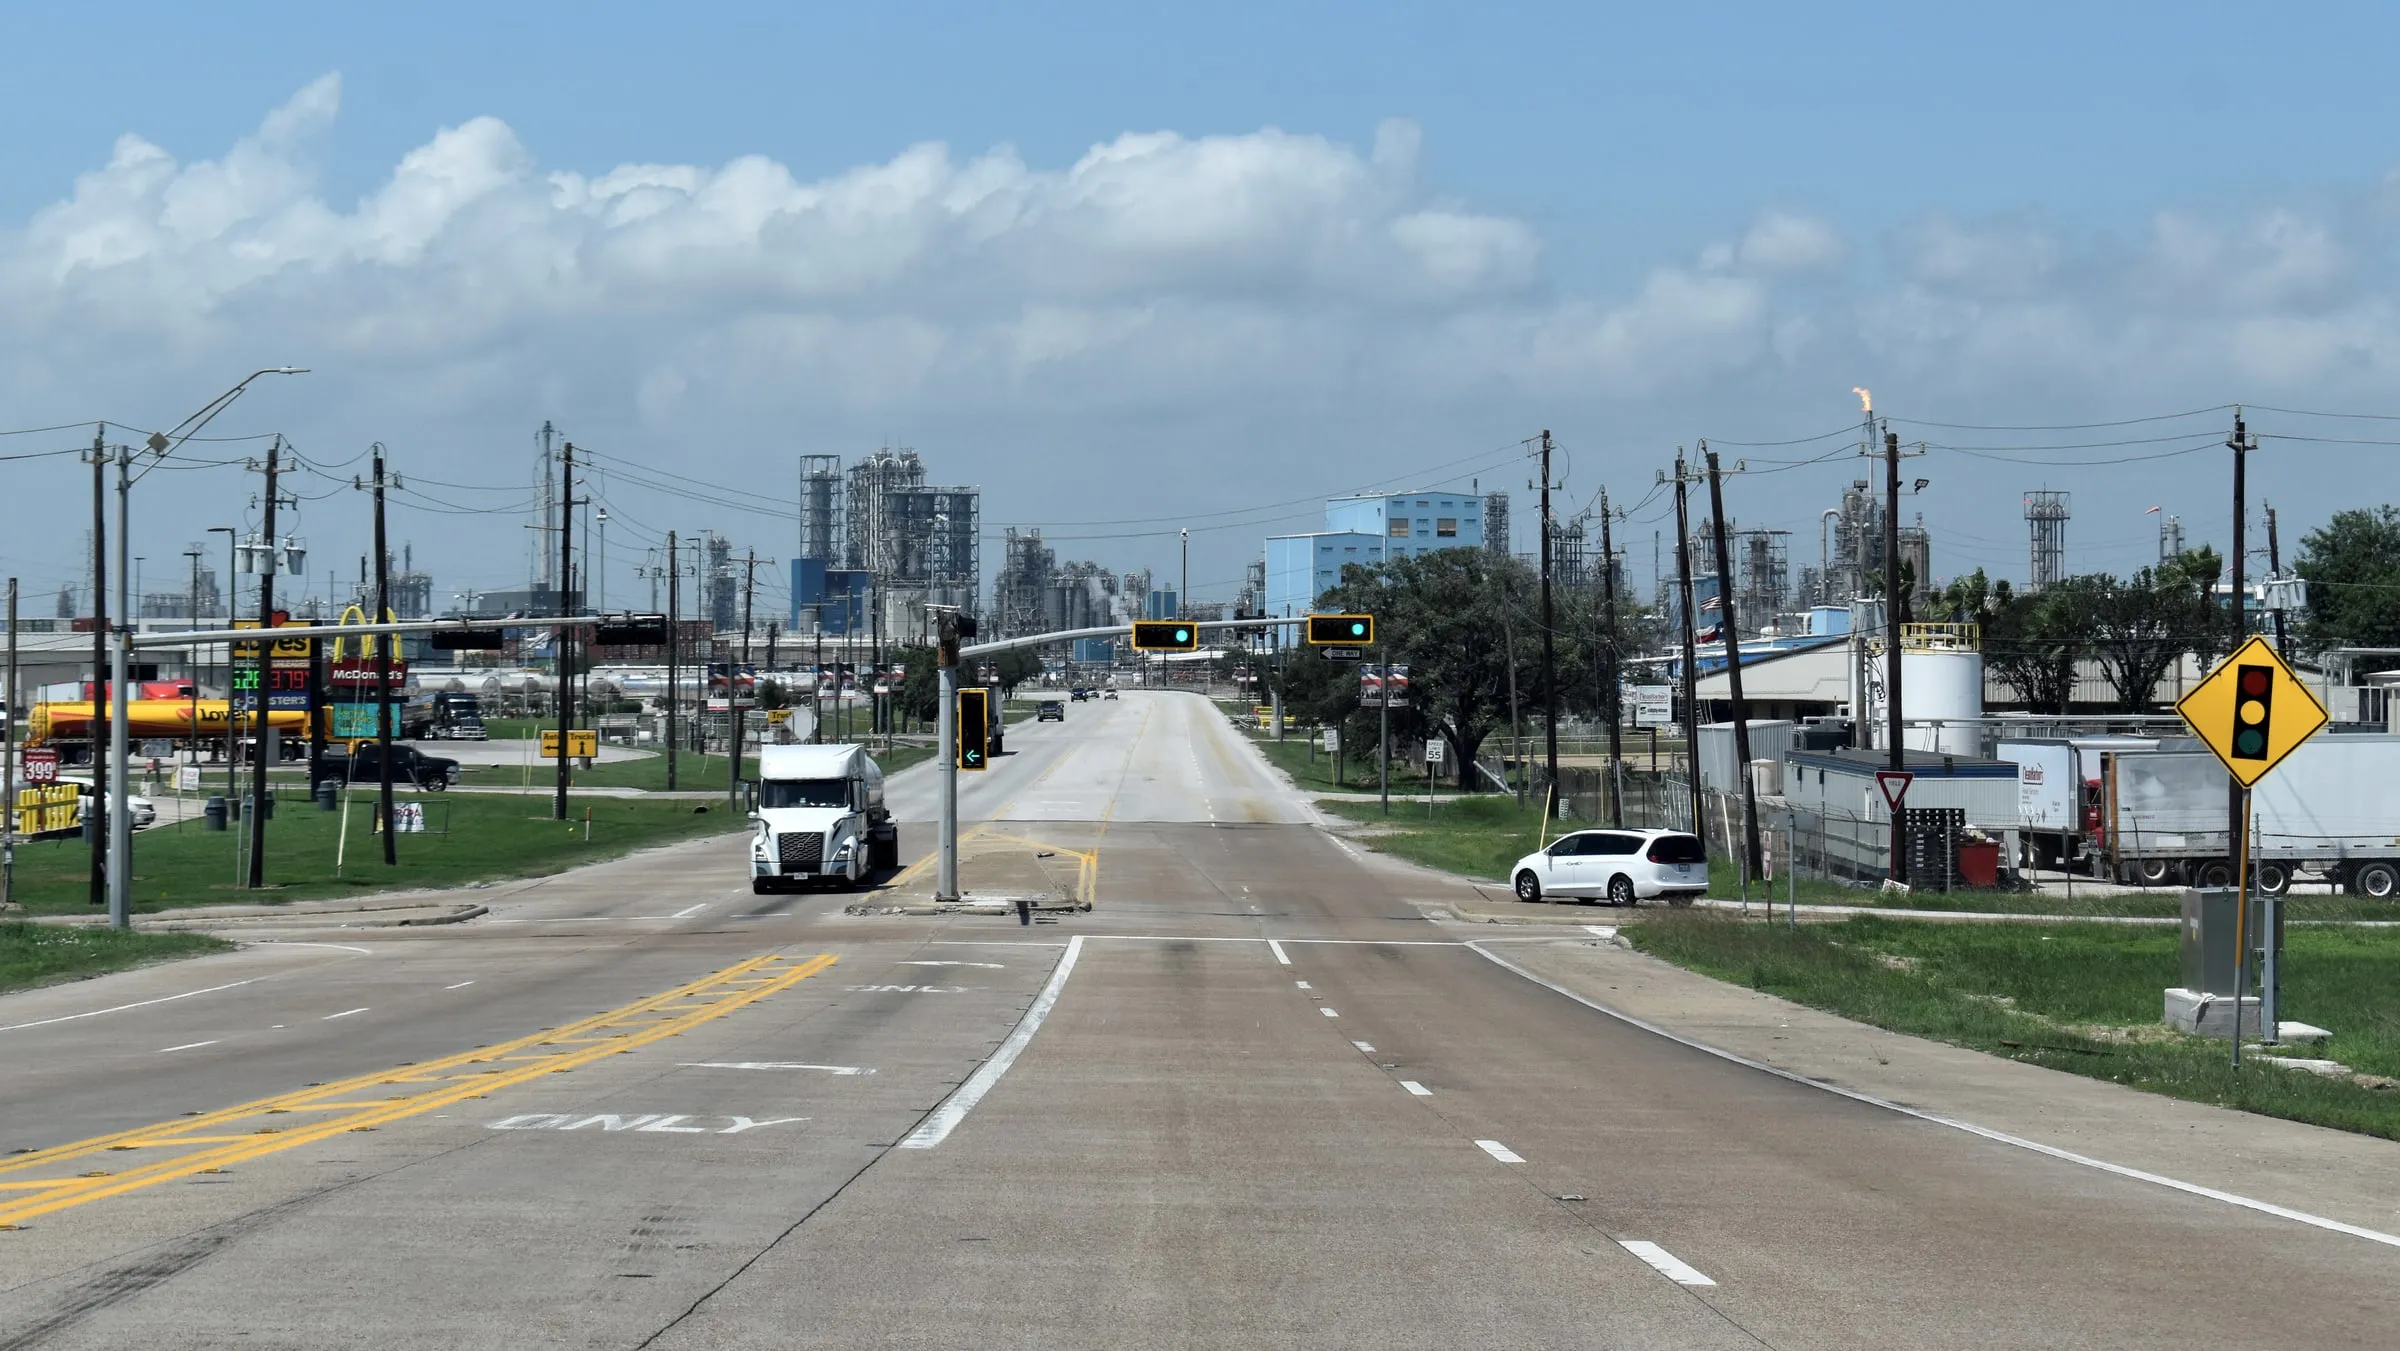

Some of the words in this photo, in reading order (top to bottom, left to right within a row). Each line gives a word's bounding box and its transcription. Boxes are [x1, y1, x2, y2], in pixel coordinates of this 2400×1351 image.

[333, 670, 403, 679] McDond's
[570, 732, 595, 740] Trucks
[1428, 751, 1441, 759] 55
[842, 985, 990, 993] ONLY
[487, 1113, 812, 1134] ONLY
